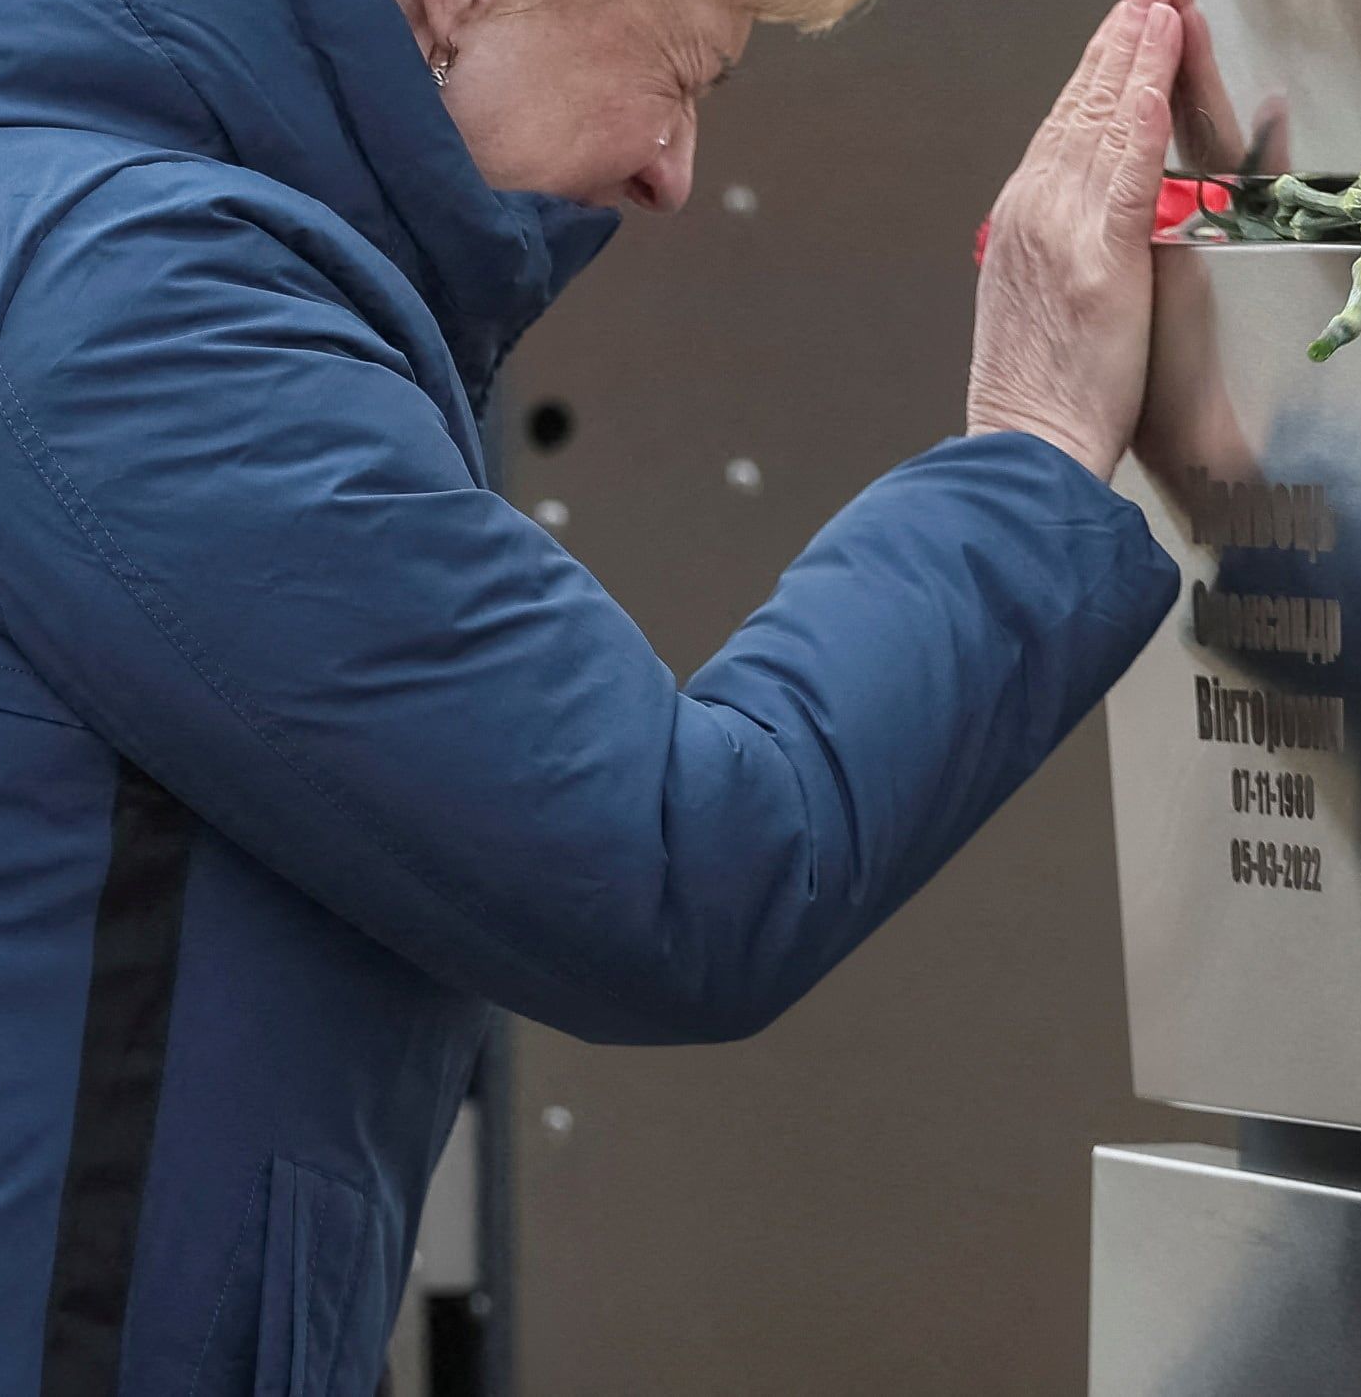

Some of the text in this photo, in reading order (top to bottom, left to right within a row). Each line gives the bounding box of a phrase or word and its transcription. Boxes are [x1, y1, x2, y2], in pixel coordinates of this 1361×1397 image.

[1194, 675, 1345, 753] Вікторович
[1231, 767, 1316, 820] 07-11-1980
[1230, 838, 1323, 893] 05-03-2022
